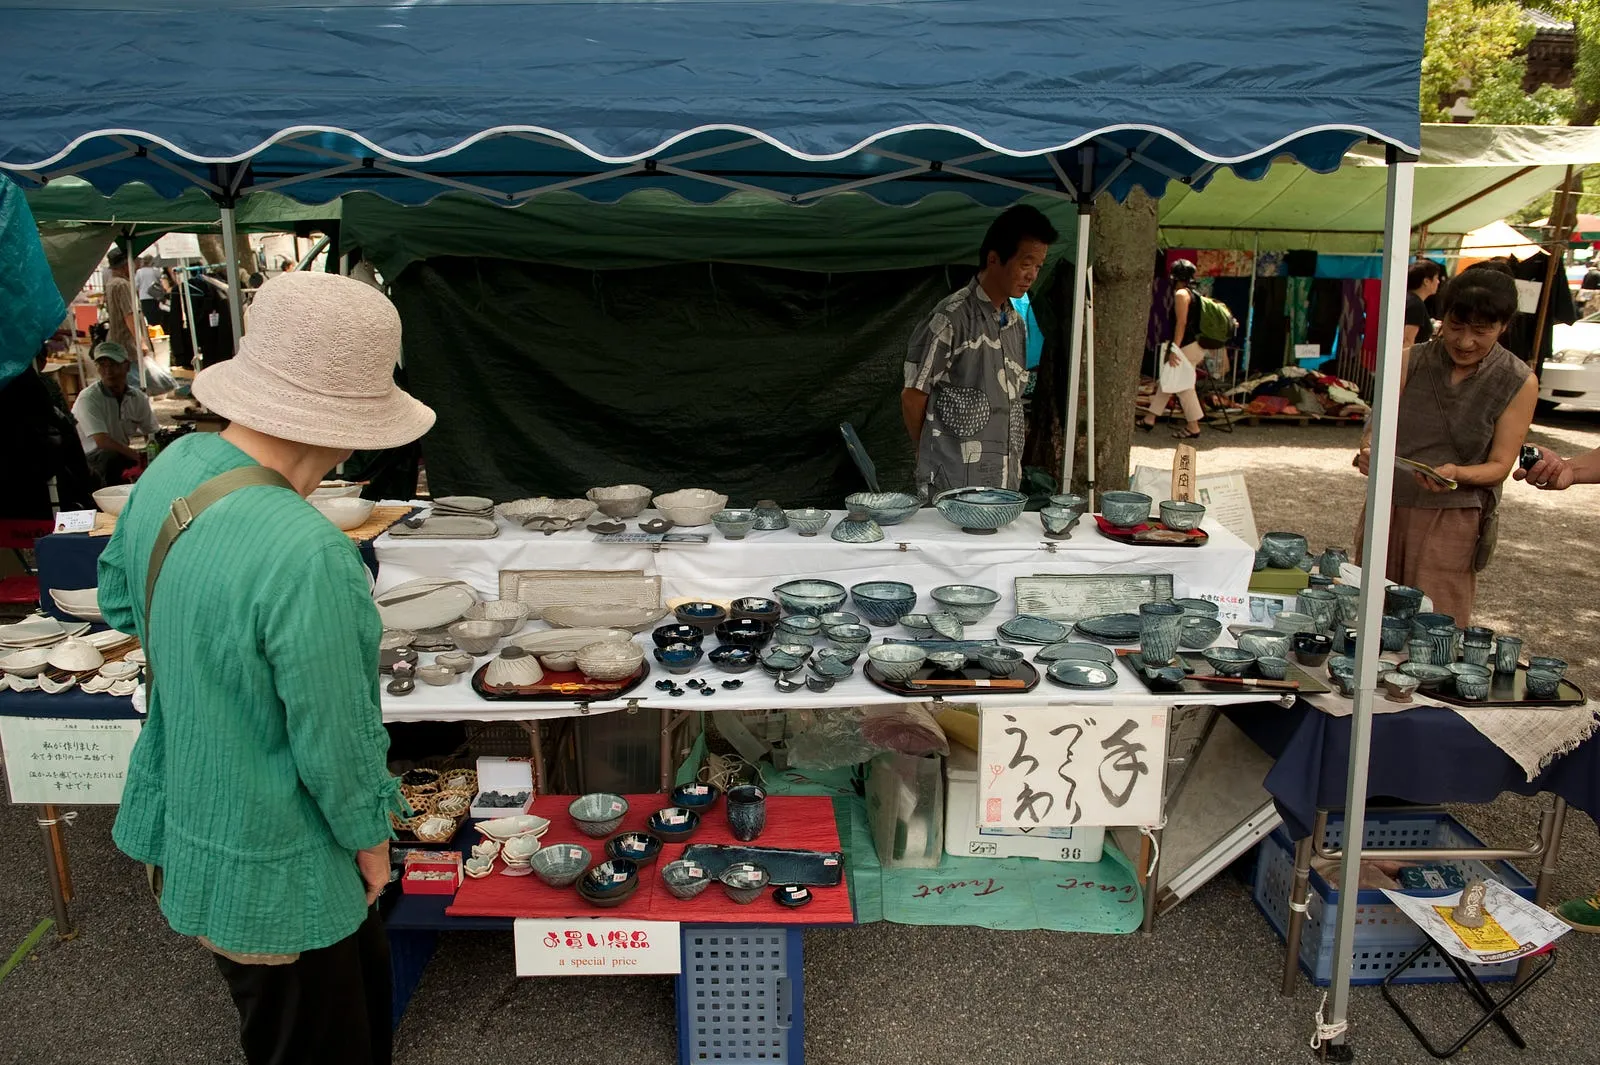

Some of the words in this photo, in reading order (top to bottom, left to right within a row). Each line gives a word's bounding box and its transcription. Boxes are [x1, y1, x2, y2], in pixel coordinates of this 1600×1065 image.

[42, 741, 100, 751] 私が作りました
[1003, 714, 1054, 823] うつわ
[1048, 717, 1097, 824] づくり
[1098, 718, 1149, 808] 手
[54, 781, 92, 791] 幸せです
[543, 930, 650, 949] お買い得品
[559, 957, 565, 966] a
[571, 956, 606, 968] special
[612, 957, 637, 968] price
